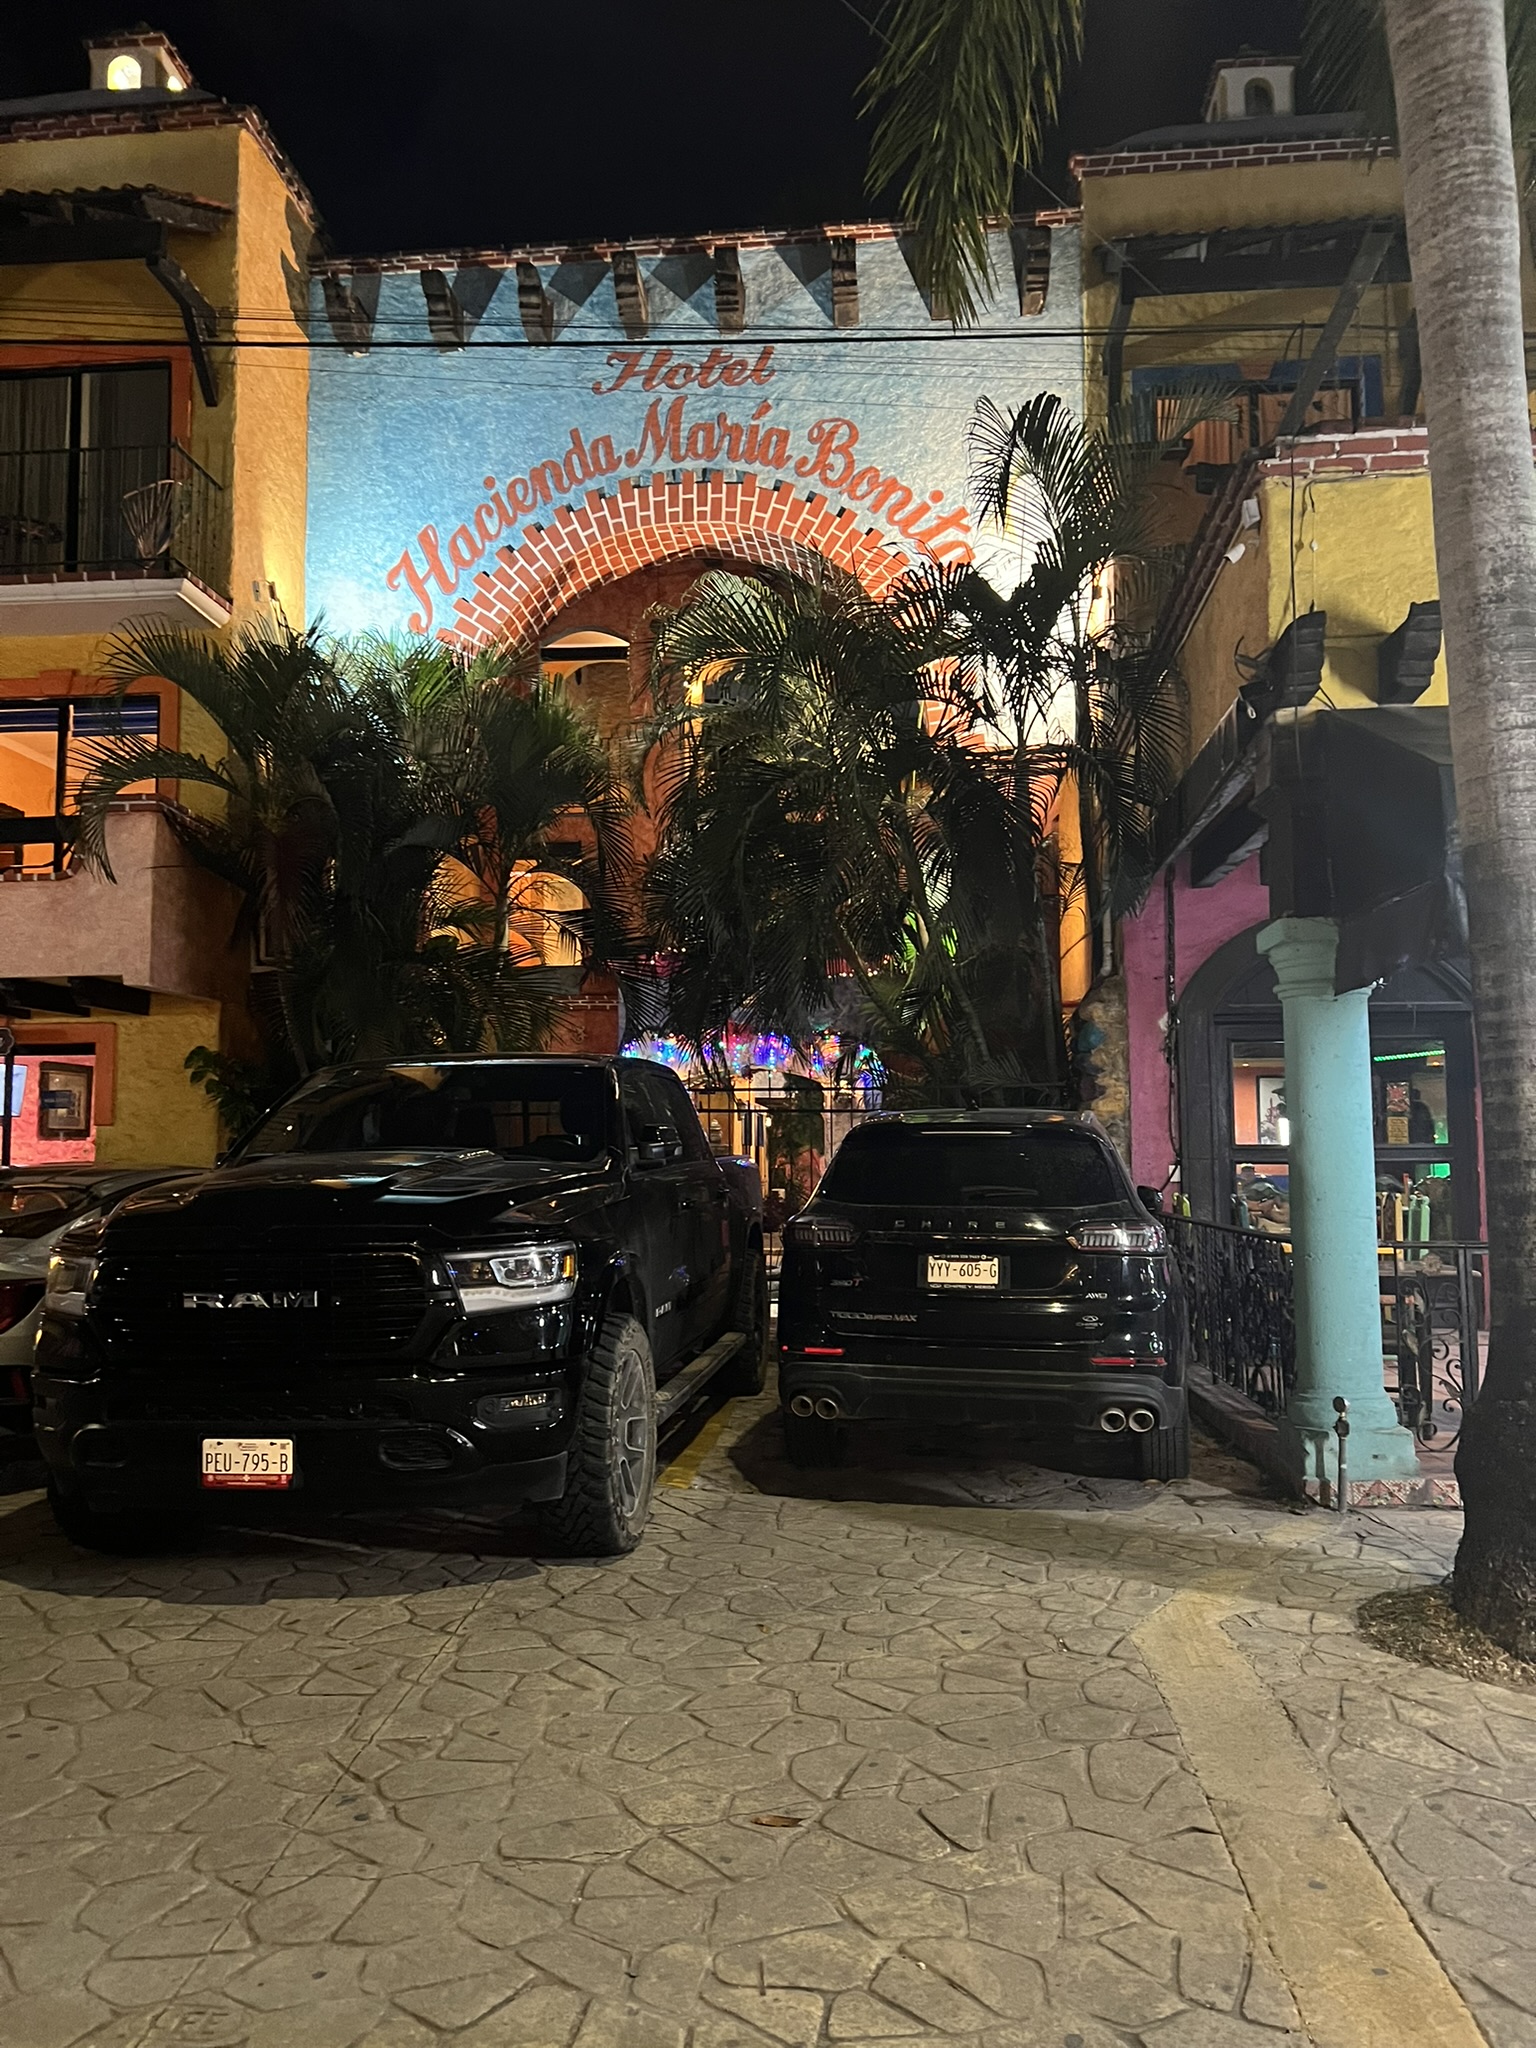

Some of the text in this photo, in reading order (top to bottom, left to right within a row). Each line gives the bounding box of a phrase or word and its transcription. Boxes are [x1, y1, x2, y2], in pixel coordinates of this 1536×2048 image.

[591, 345, 777, 395] Hotel
[386, 427, 623, 635] Hacienda
[625, 395, 793, 470] María
[894, 1219, 1034, 1229] CHIRE
[929, 1262, 997, 1278] YYY-605-G
[183, 1290, 318, 1308] RAM
[205, 1452, 289, 1473] PEU-795-B
